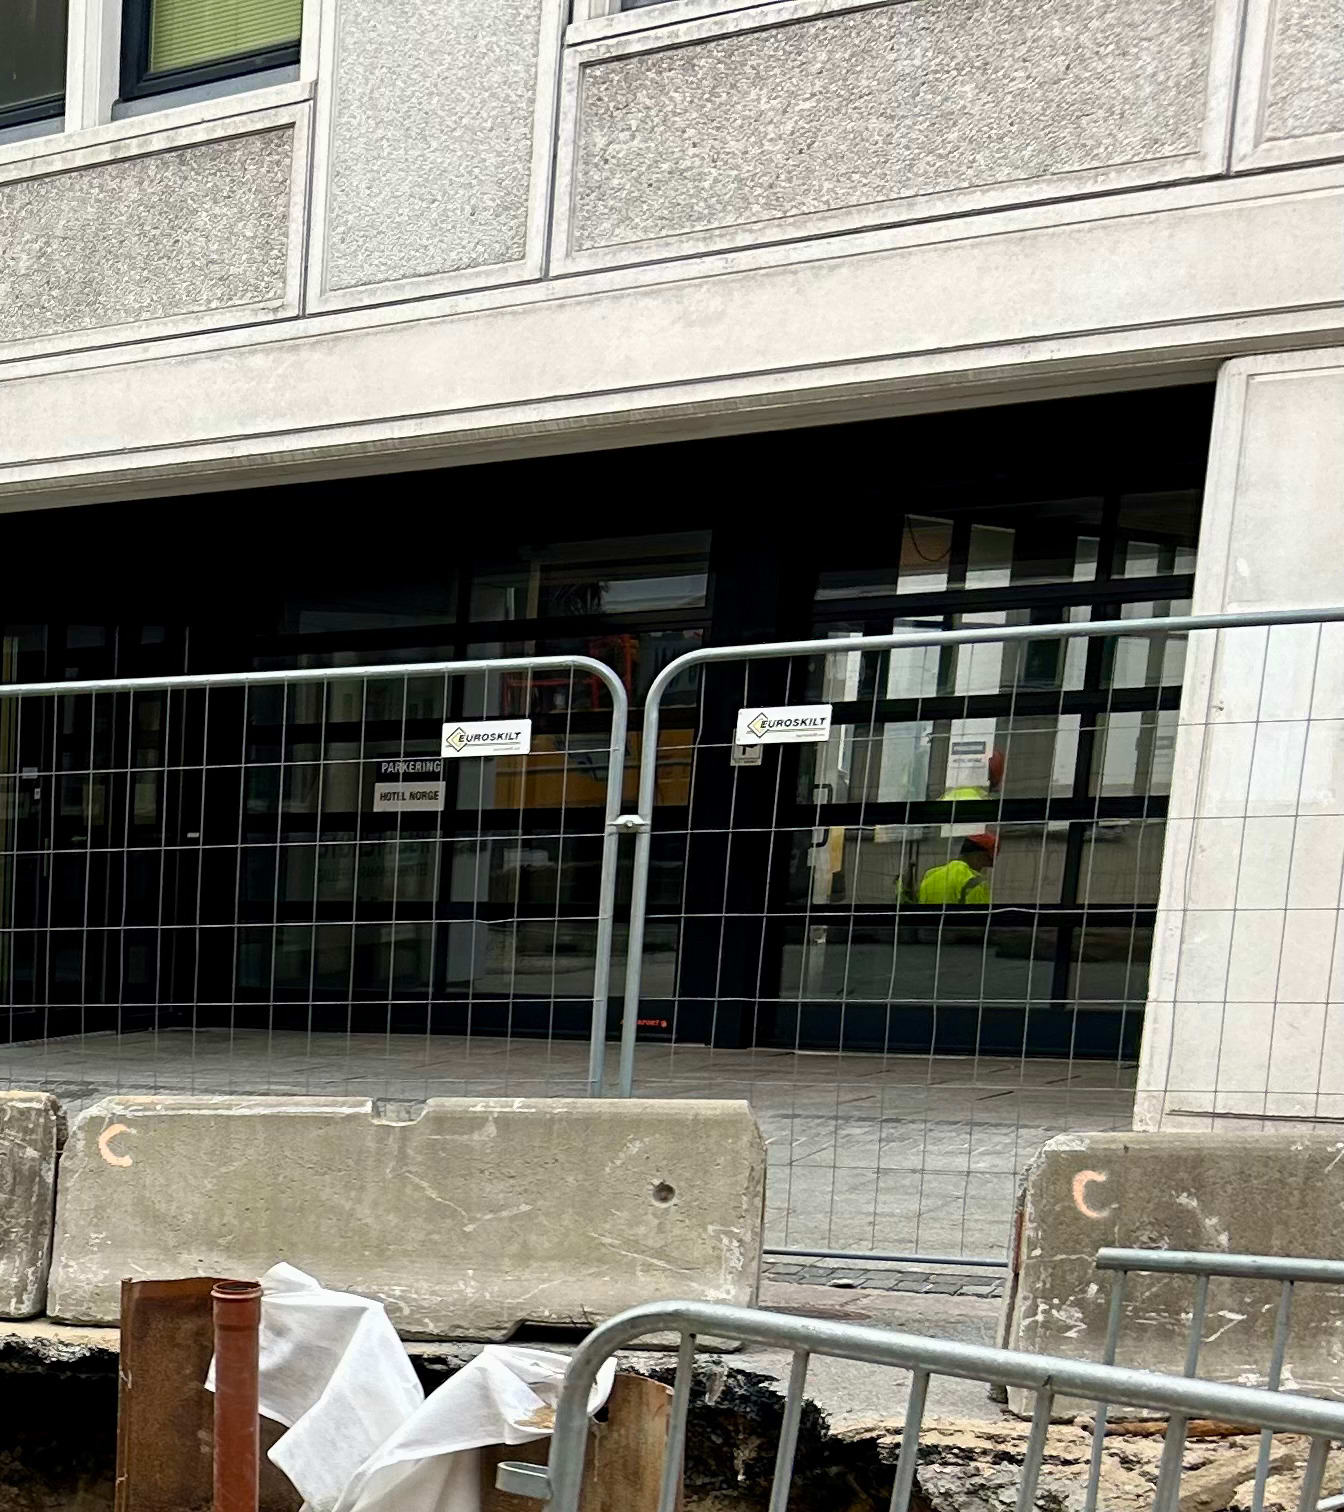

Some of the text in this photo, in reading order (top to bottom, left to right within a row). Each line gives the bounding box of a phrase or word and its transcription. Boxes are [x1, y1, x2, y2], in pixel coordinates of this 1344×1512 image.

[760, 717, 827, 729] EUROSKILT
[458, 731, 522, 743] EUROSKILT
[381, 760, 441, 774] PARKERING
[409, 789, 440, 801] NORGE
